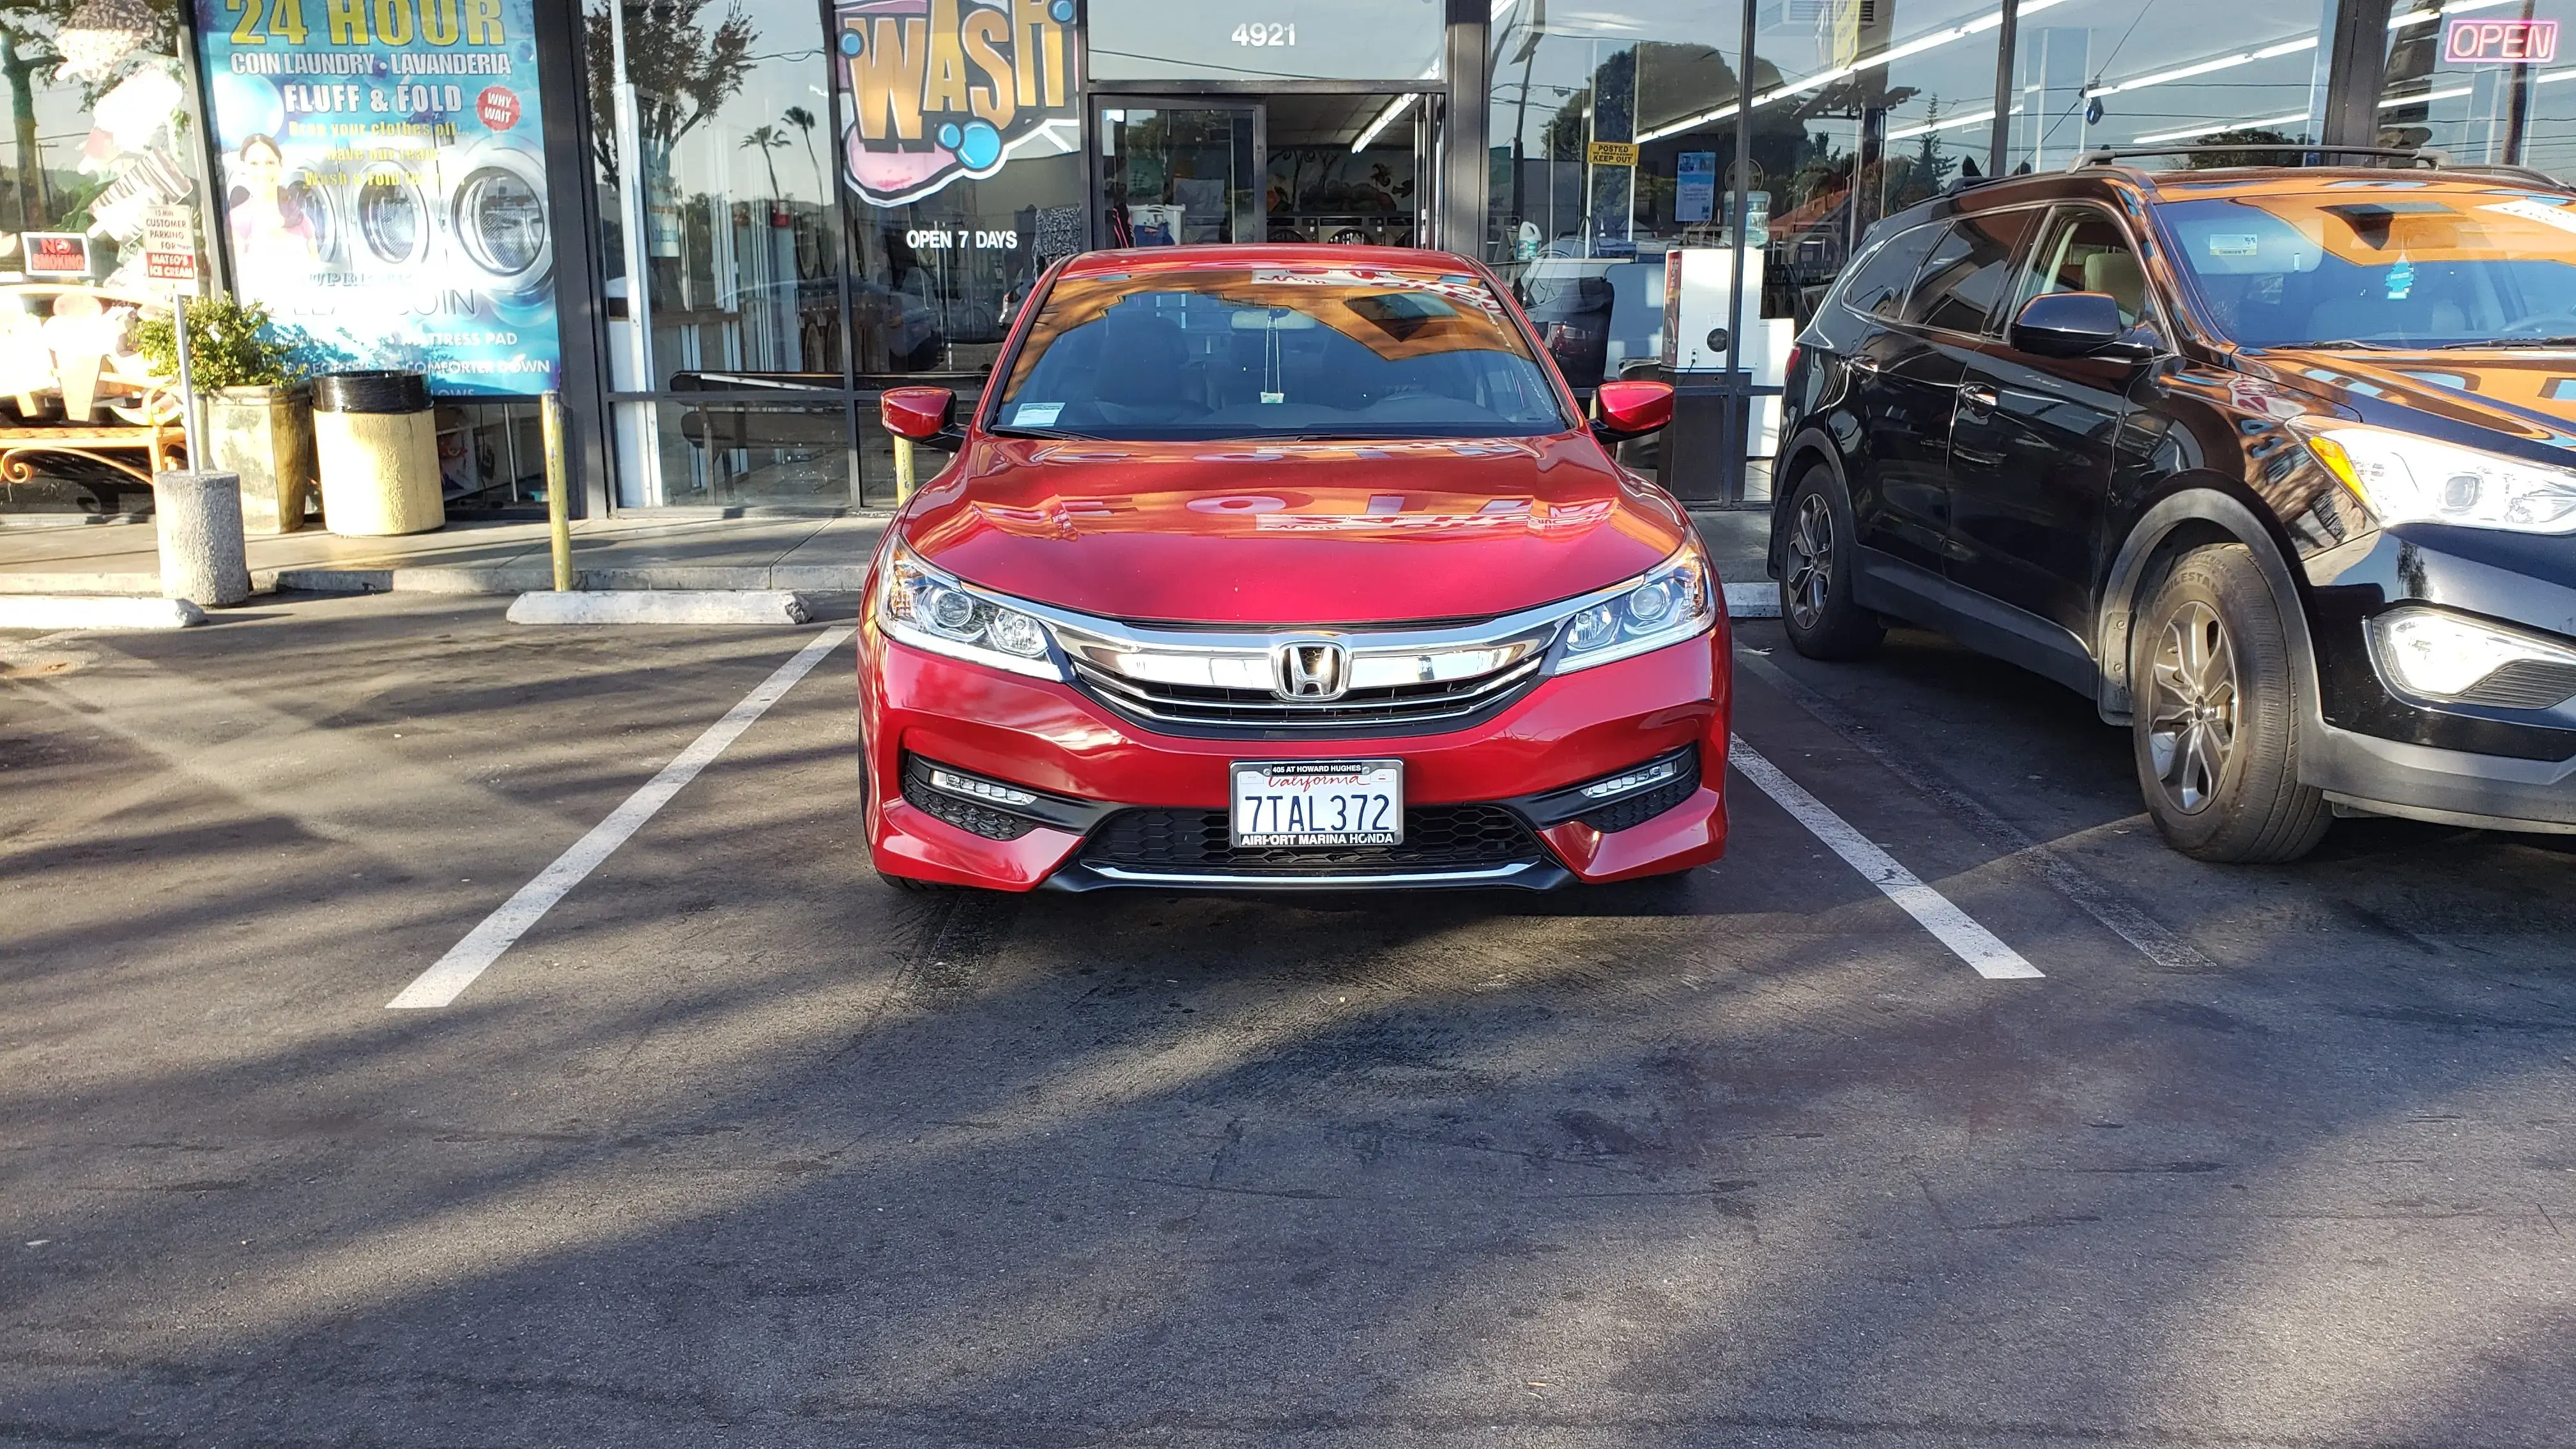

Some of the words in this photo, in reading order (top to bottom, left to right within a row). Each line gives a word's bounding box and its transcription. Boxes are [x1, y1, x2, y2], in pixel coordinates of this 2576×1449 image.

[226, 0, 309, 46] 24
[325, 0, 505, 47] HOUR
[1231, 22, 1295, 47] 4921
[2453, 24, 2552, 58] OPEN
[230, 52, 280, 75] COIN
[283, 53, 374, 75] LAUNDRY
[390, 53, 512, 75] LAVANDERIA
[845, 0, 1064, 139] WASH
[284, 84, 360, 112] FLUFF
[370, 88, 389, 112] &
[397, 84, 463, 112] FOLD
[487, 92, 512, 109] WHY
[484, 106, 511, 123] WAIT
[330, 123, 366, 138] your
[371, 121, 431, 136] clothes
[146, 218, 187, 228] CUSTOMER
[150, 229, 184, 240] PARKING
[906, 230, 953, 249] OPEN
[958, 231, 969, 249] 7
[976, 231, 1018, 249] DAYS
[40, 239, 71, 254] NO
[160, 241, 176, 250] FOR
[32, 253, 84, 270] SMOKING
[151, 254, 188, 266] MATEO'S
[149, 265, 163, 277] ICE
[164, 266, 194, 278] CREAM
[485, 332, 518, 346] PAD
[498, 359, 550, 373] DOWN
[1268, 775, 1370, 792] California
[1245, 794, 1390, 832] 7TAL372
[1241, 835, 1296, 846] AIRPORT
[1298, 834, 1347, 845] MARINA
[1349, 833, 1394, 844] HONDA
